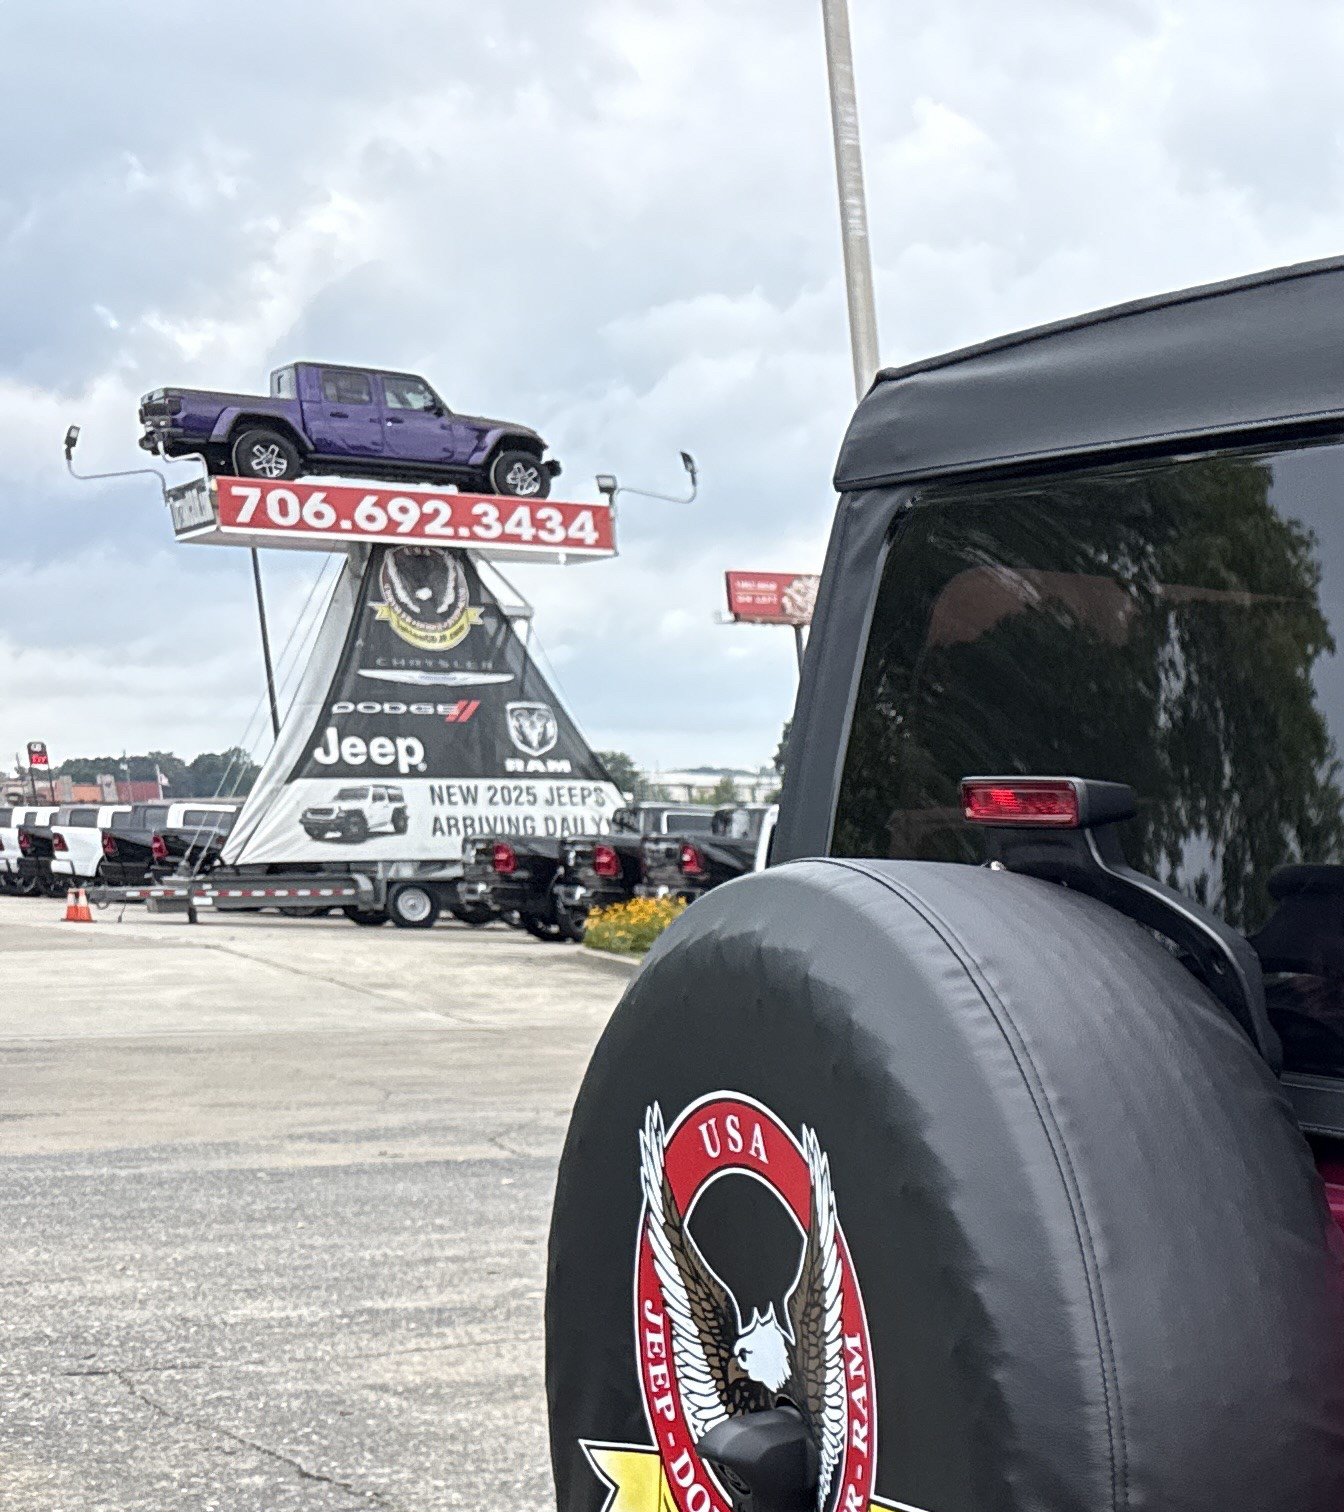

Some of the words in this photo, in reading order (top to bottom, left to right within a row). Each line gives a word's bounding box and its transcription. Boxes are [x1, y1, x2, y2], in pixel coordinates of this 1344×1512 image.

[230, 485, 599, 546] 706.692.3434
[331, 701, 459, 715] DODGE
[313, 727, 425, 774] Jeep
[504, 758, 572, 773] RAM
[429, 784, 478, 806] NEW
[487, 784, 537, 806] 2025
[544, 785, 606, 807] JEEPS
[431, 815, 536, 838] ARRIVING
[698, 1114, 769, 1165] USA
[644, 1299, 675, 1422] JEEP
[845, 1332, 869, 1457] RAM
